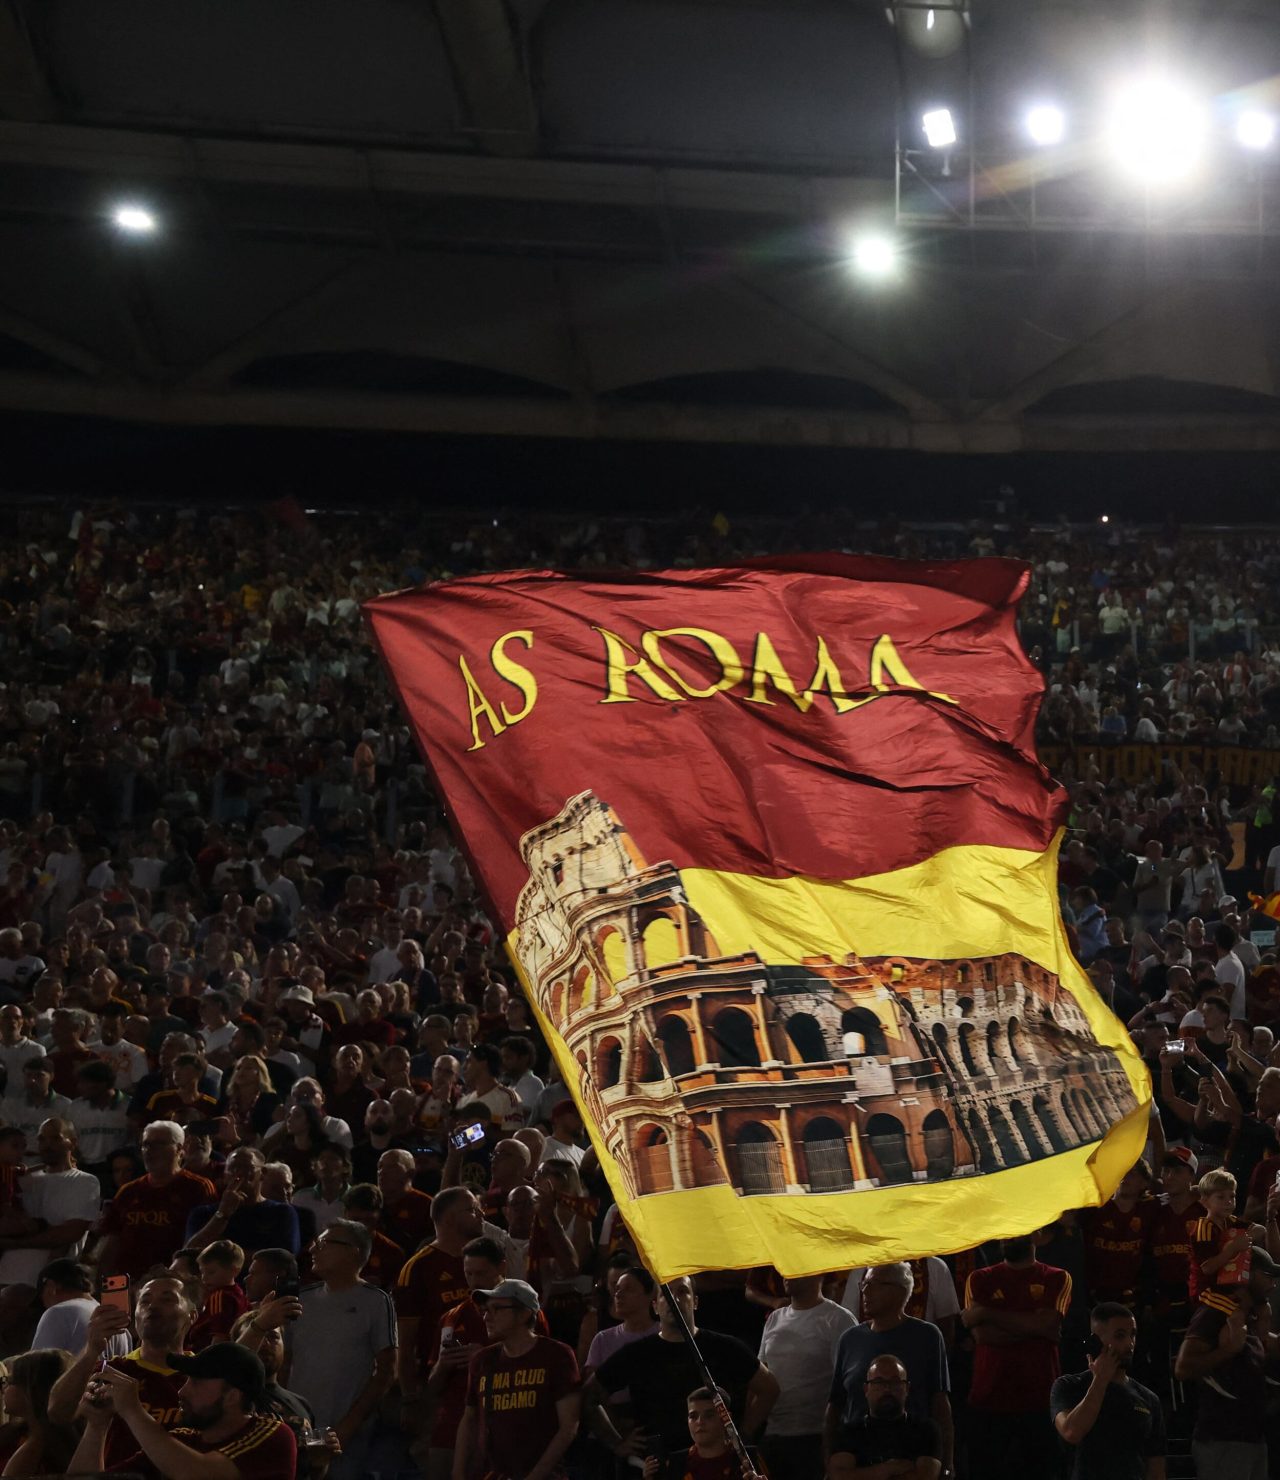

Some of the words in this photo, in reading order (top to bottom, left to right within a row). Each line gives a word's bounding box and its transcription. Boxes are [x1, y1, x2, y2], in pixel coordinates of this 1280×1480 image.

[459, 630, 538, 753] AS
[590, 625, 960, 714] ROMA
[127, 1209, 171, 1227] SPQR
[479, 1371, 511, 1393] RMA
[514, 1368, 546, 1387] CLUB
[480, 1390, 537, 1411] RGAMO
